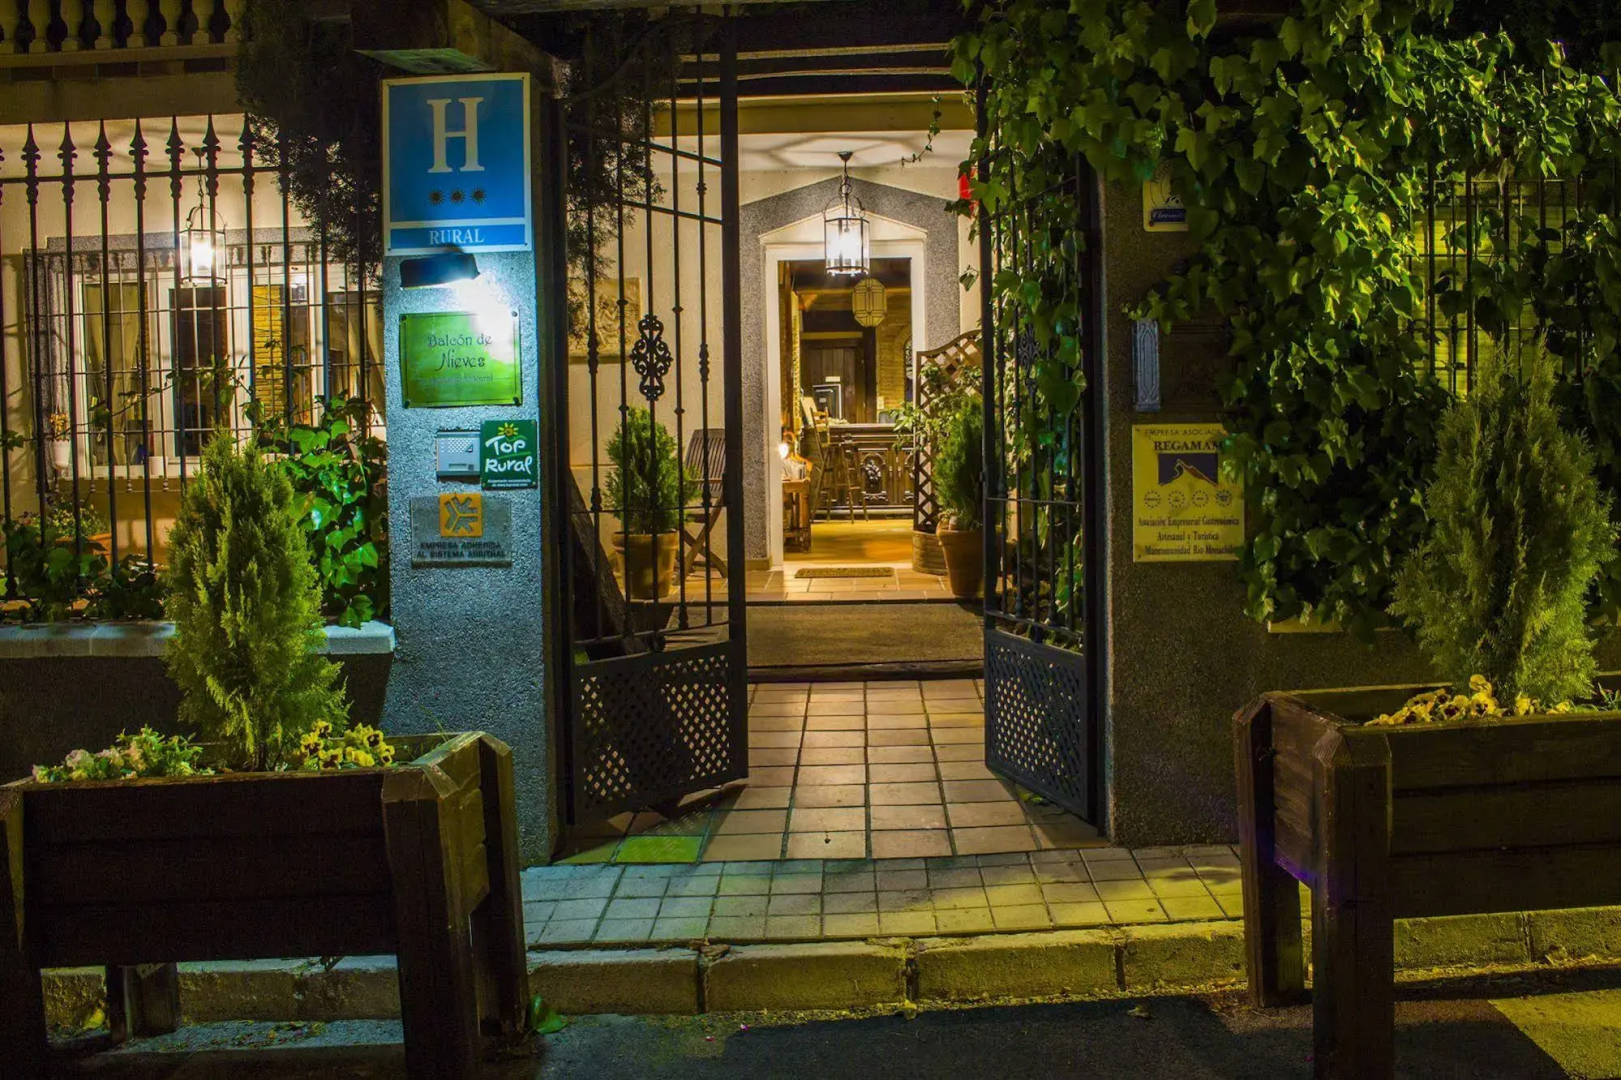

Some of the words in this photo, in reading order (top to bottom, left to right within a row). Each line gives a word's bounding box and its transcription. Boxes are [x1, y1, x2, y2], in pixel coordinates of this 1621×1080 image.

[426, 97, 485, 173] H
[429, 228, 485, 245] RURAL
[427, 334, 473, 348] Balcón
[476, 333, 493, 346] de
[434, 349, 485, 372] Nieves
[1144, 428, 1179, 436] EMPRESA
[485, 435, 526, 455] Top
[485, 455, 533, 475] Rural
[1157, 532, 1186, 541] Artesanal
[420, 541, 458, 549] EMPRESA
[461, 541, 501, 549] ADHERIDA
[1145, 545, 1190, 555] Mancomunidad
[416, 550, 426, 558] AL
[429, 550, 465, 558] SISTEMA
[467, 550, 507, 558] ARBITRAL
